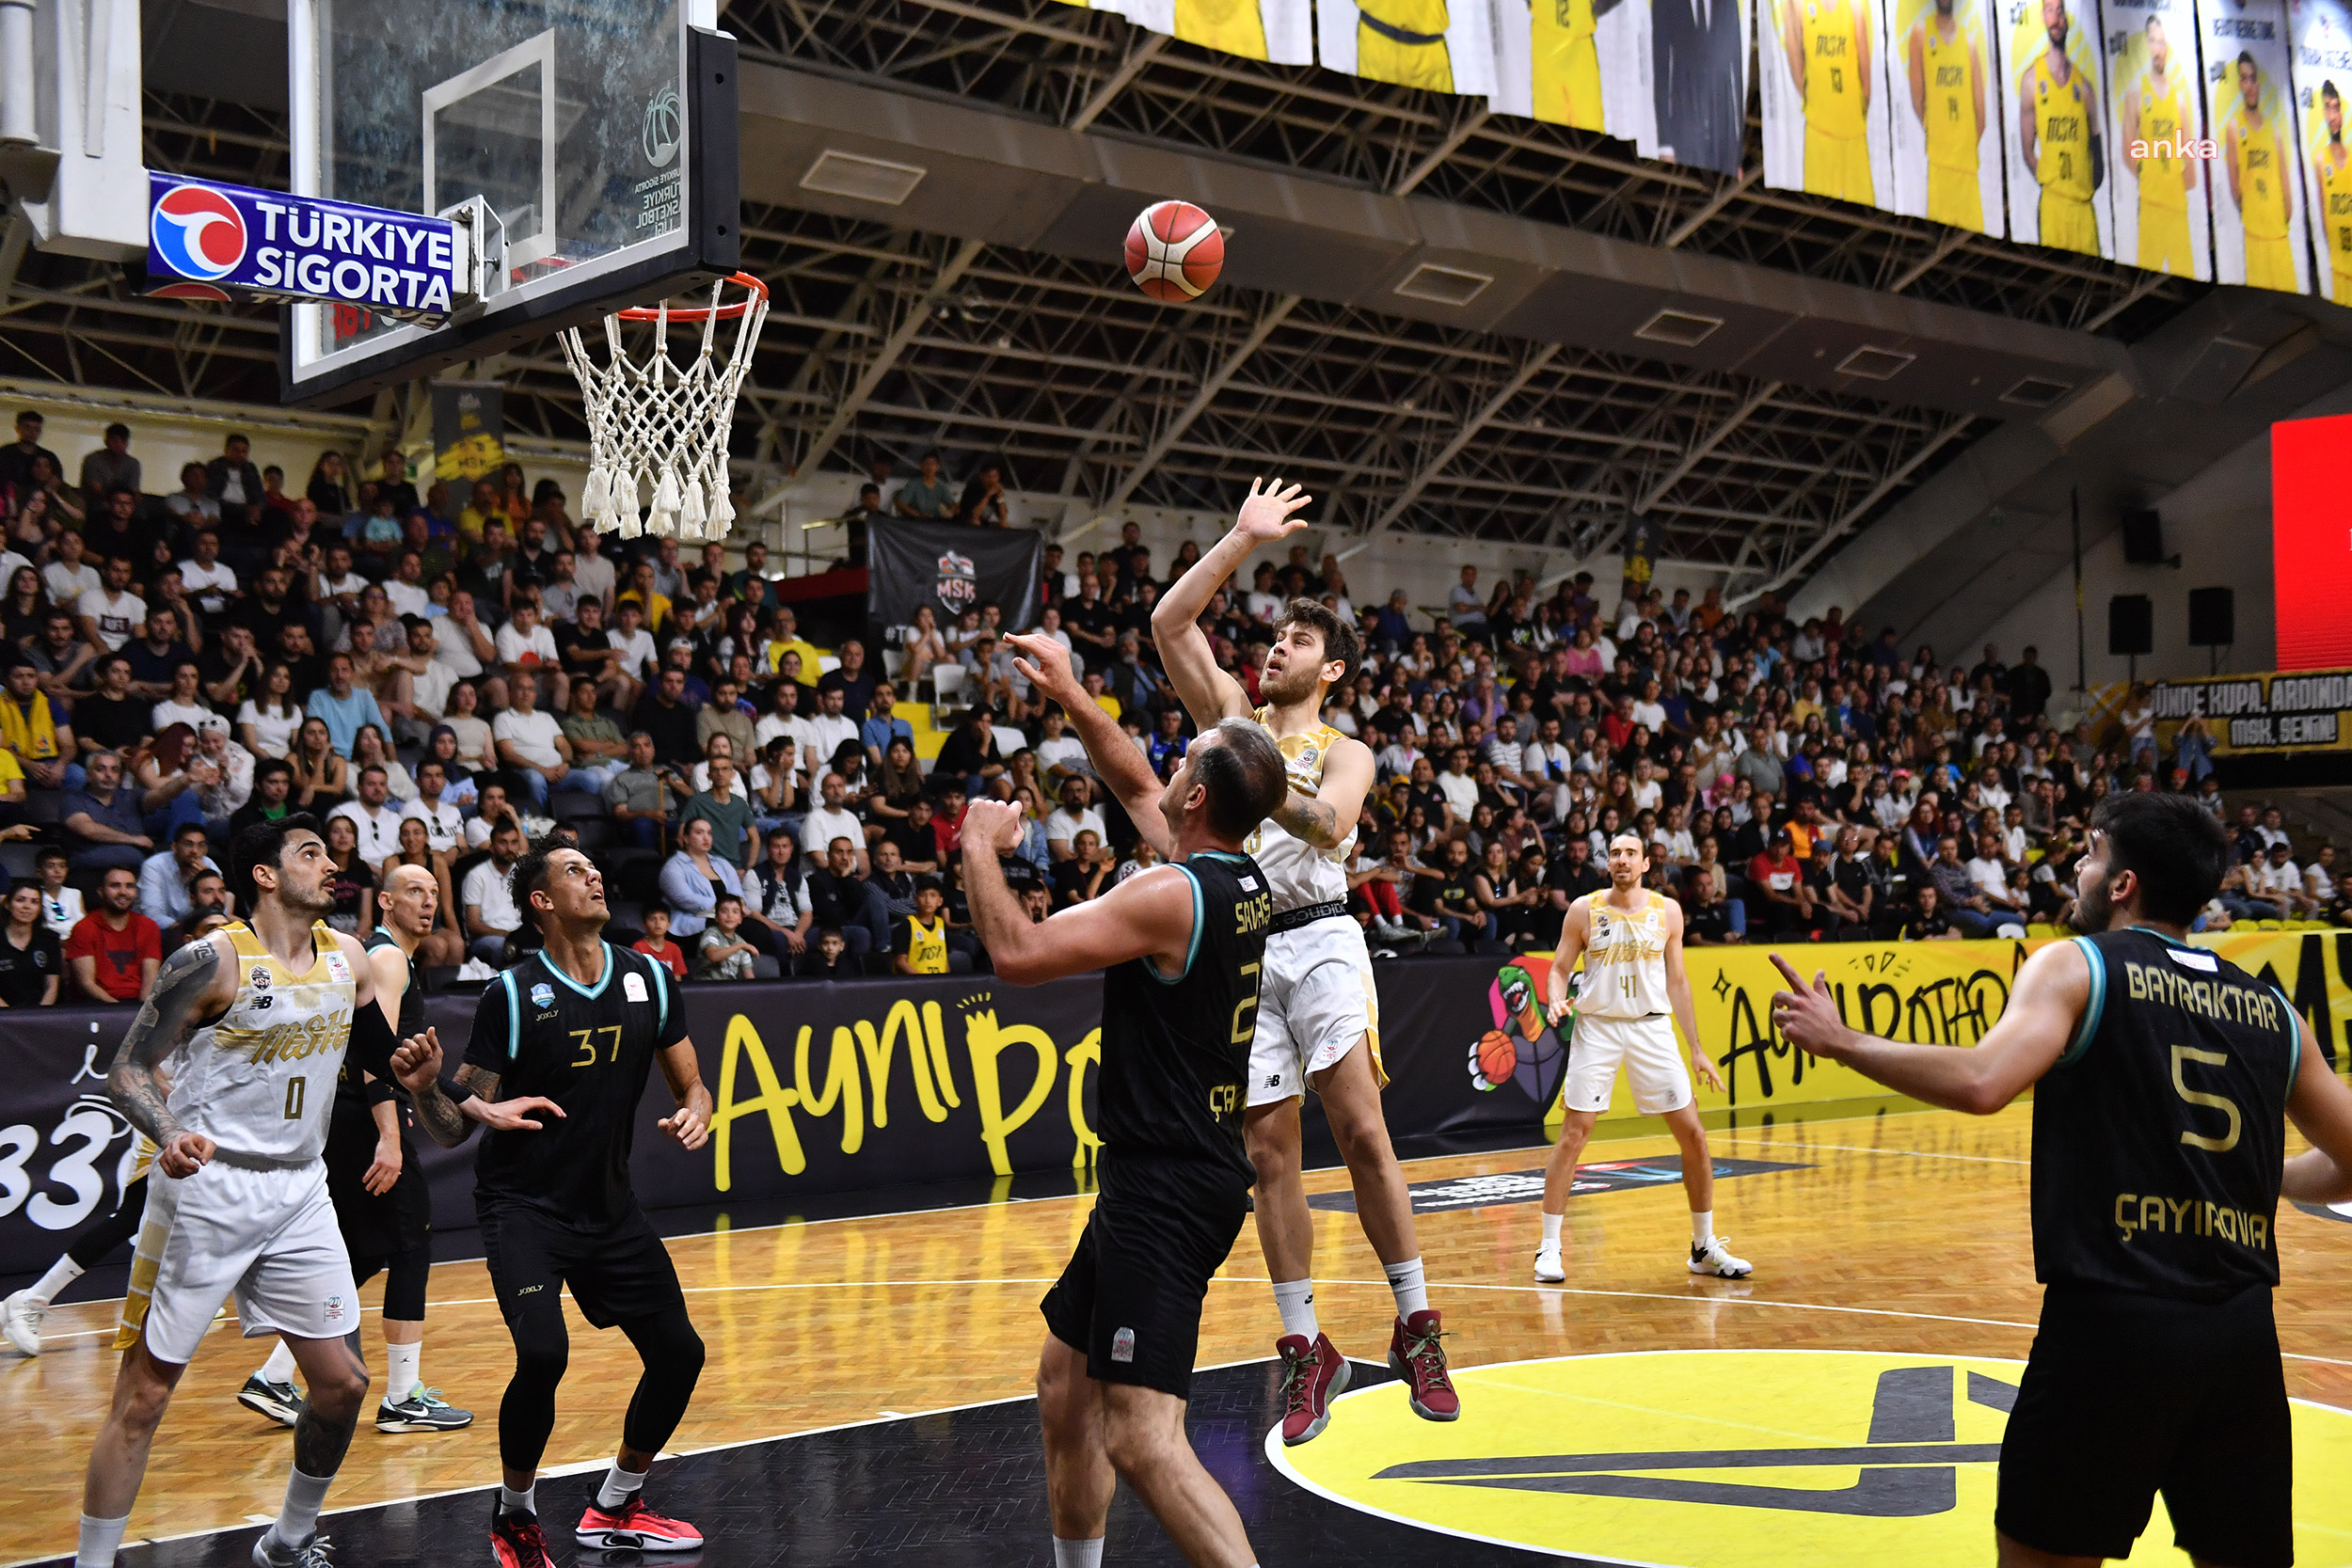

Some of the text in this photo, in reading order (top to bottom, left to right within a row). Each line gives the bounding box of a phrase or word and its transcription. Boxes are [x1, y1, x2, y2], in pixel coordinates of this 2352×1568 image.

[256, 201, 452, 270] TÜRKİYE
[254, 246, 451, 312] SİGORTA
[937, 578, 977, 600] MSK
[1603, 939, 1655, 967] MSK
[253, 977, 272, 987] MSK
[1619, 974, 1637, 998] 41
[2124, 960, 2280, 1032] BAYRAKTAR
[249, 1007, 348, 1066] MSK
[535, 1009, 559, 1022] JOXLY
[568, 1024, 623, 1068] 37
[284, 1076, 306, 1119] 0
[2170, 1044, 2242, 1152] 5
[2115, 1193, 2267, 1250] ÇAYIROVA
[517, 1284, 544, 1296] JOXLY
